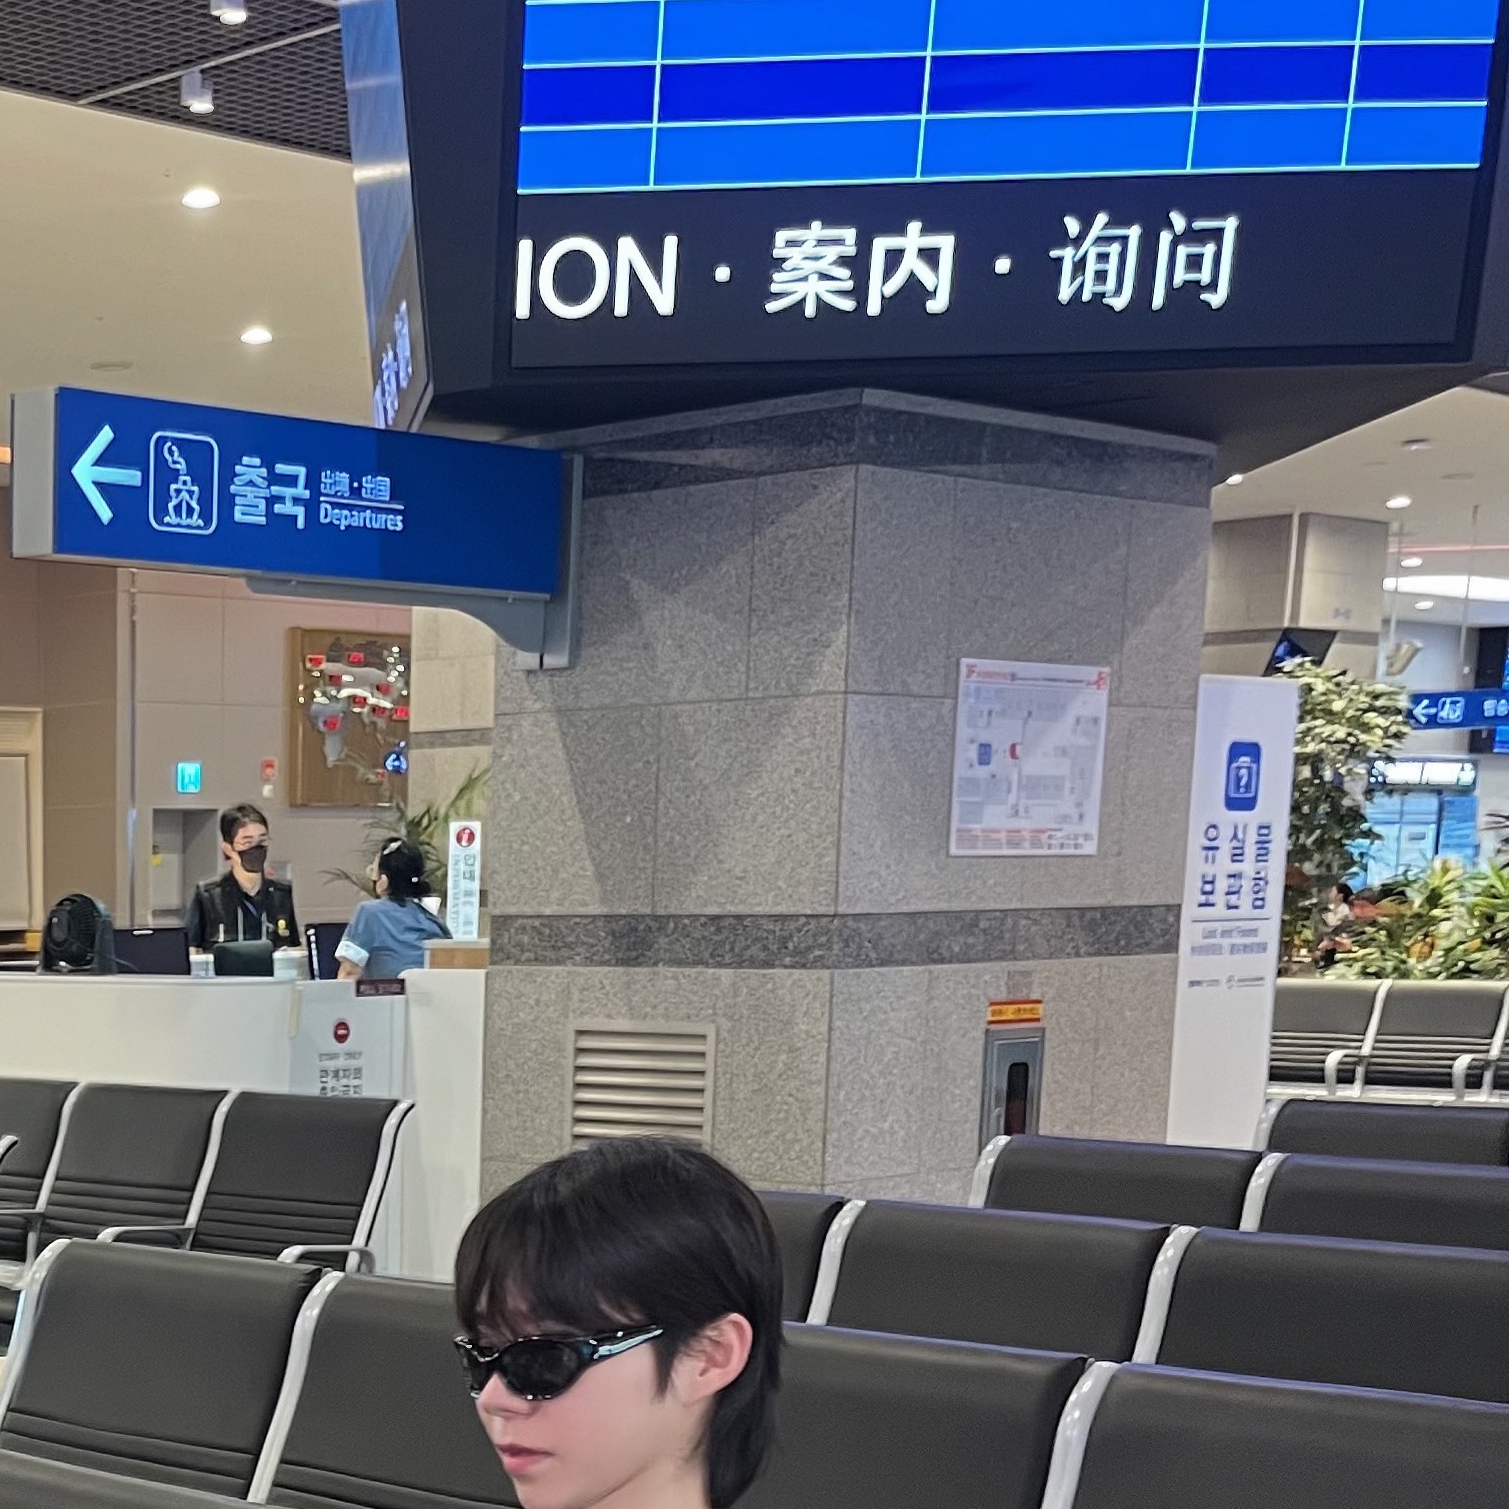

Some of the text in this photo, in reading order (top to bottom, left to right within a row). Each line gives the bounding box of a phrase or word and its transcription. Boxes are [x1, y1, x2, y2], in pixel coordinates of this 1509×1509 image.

[515, 234, 678, 319] ION
[764, 211, 1239, 318] 案内 询问
[229, 456, 311, 530] 출국
[319, 502, 404, 531] Departures
[1200, 822, 1273, 865] 유실물
[1197, 870, 1270, 911] 보관함
